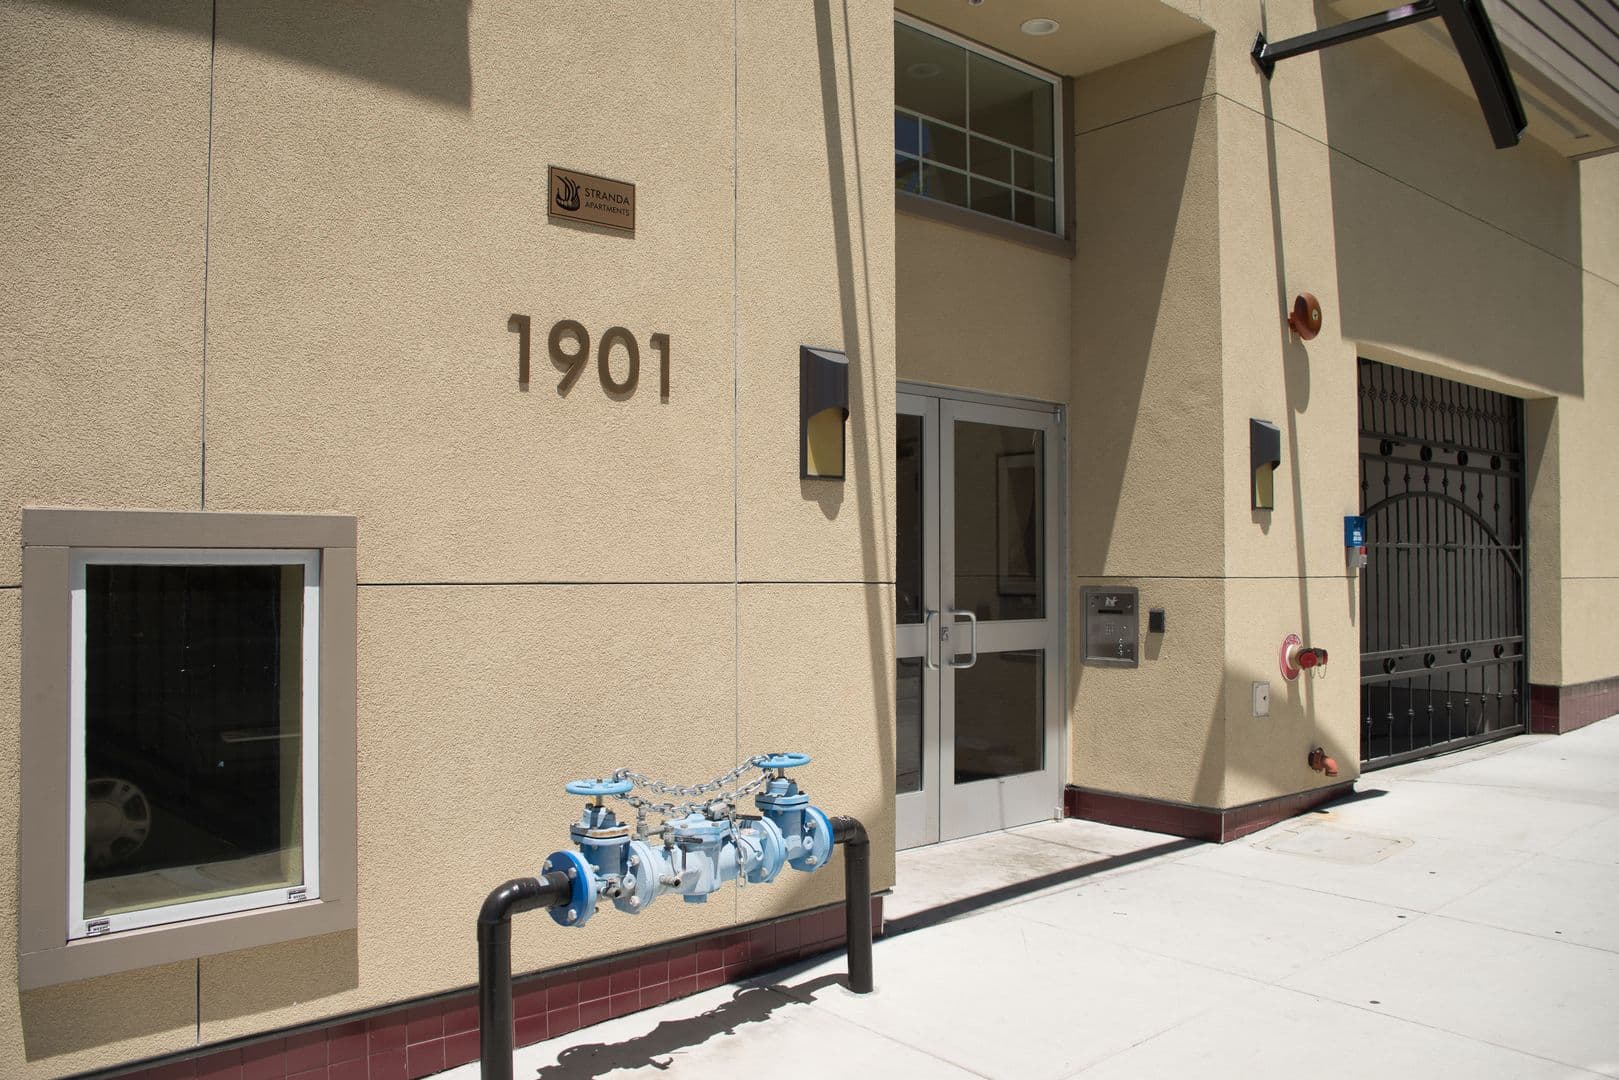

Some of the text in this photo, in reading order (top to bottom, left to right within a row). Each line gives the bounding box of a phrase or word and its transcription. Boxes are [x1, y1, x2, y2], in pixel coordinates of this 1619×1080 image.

[584, 187, 630, 206] STRANDA
[584, 201, 631, 217] APARTMENTS
[507, 313, 671, 400] 1901
